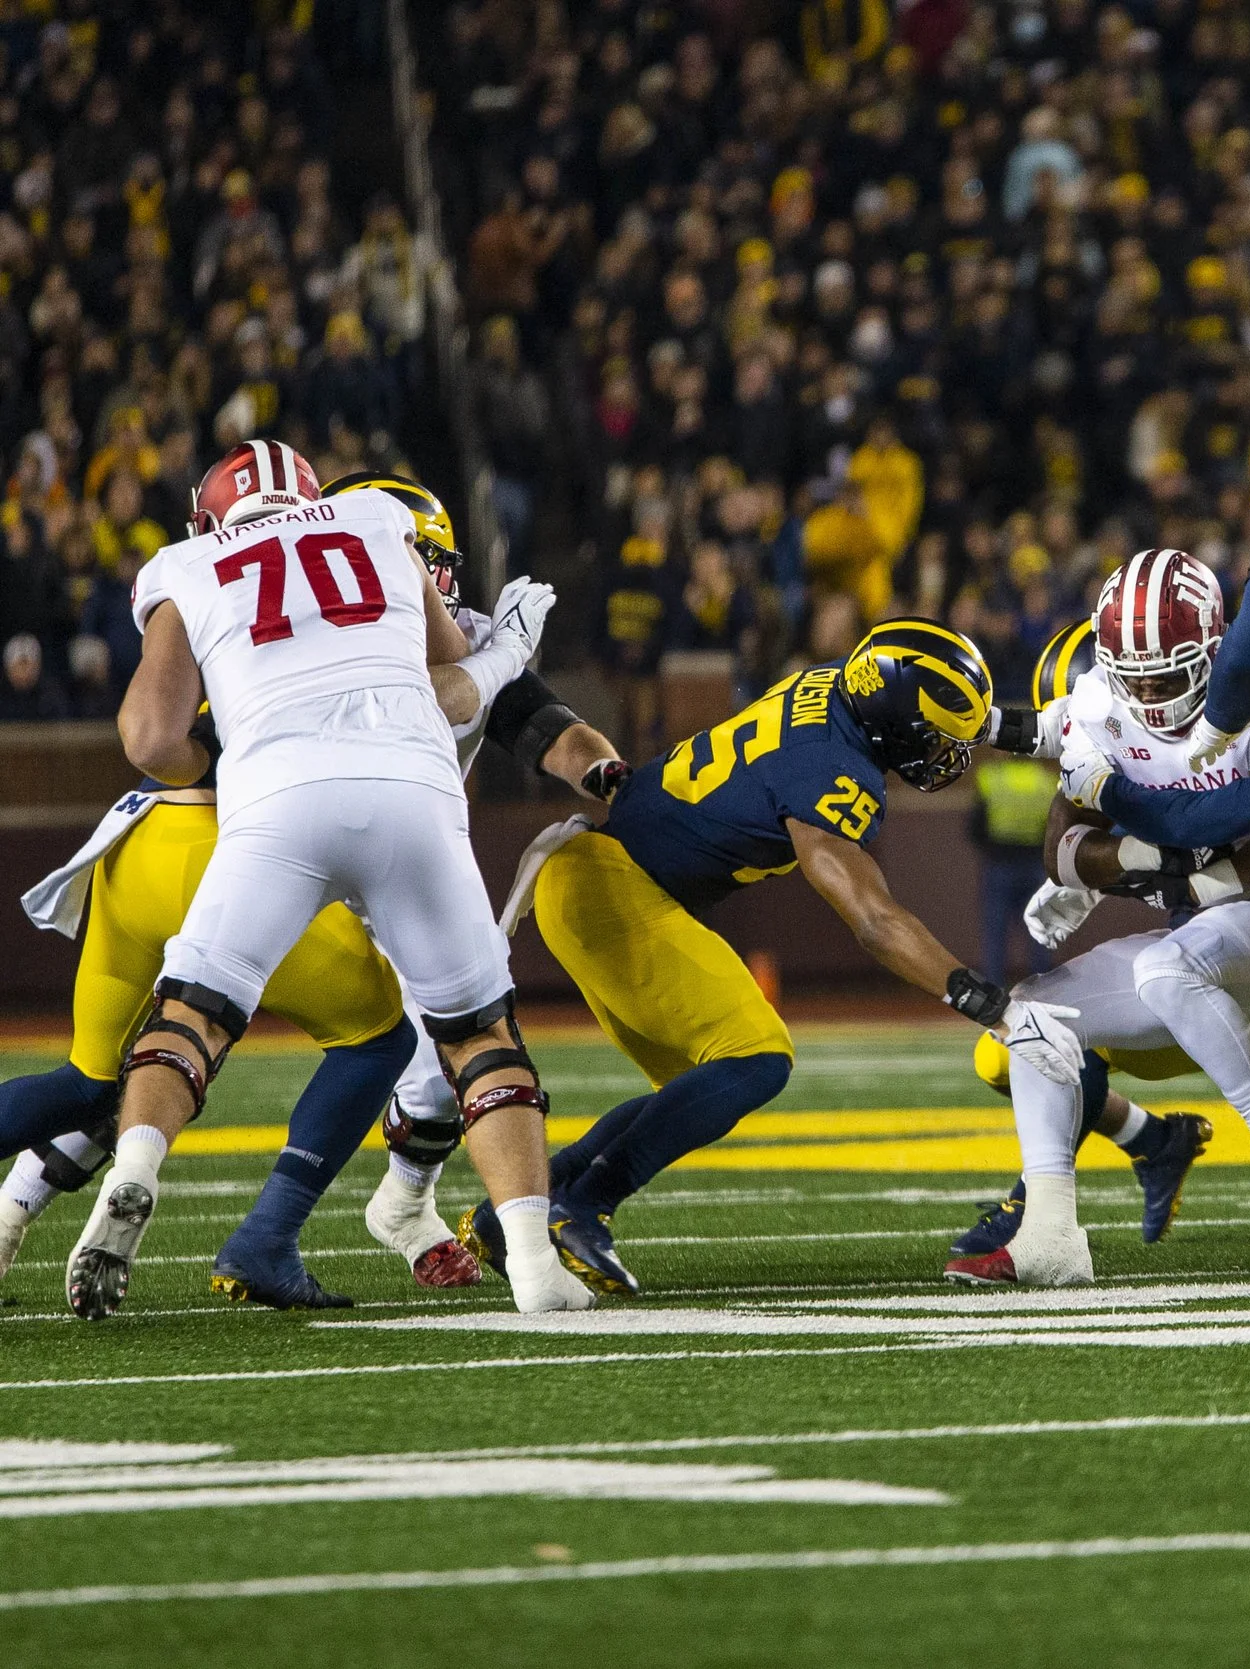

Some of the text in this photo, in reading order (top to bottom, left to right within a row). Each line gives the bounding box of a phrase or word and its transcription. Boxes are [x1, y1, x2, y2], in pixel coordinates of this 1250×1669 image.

[213, 532, 387, 646] 70
[1133, 652, 1151, 662] LEO
[815, 775, 880, 840] 25
